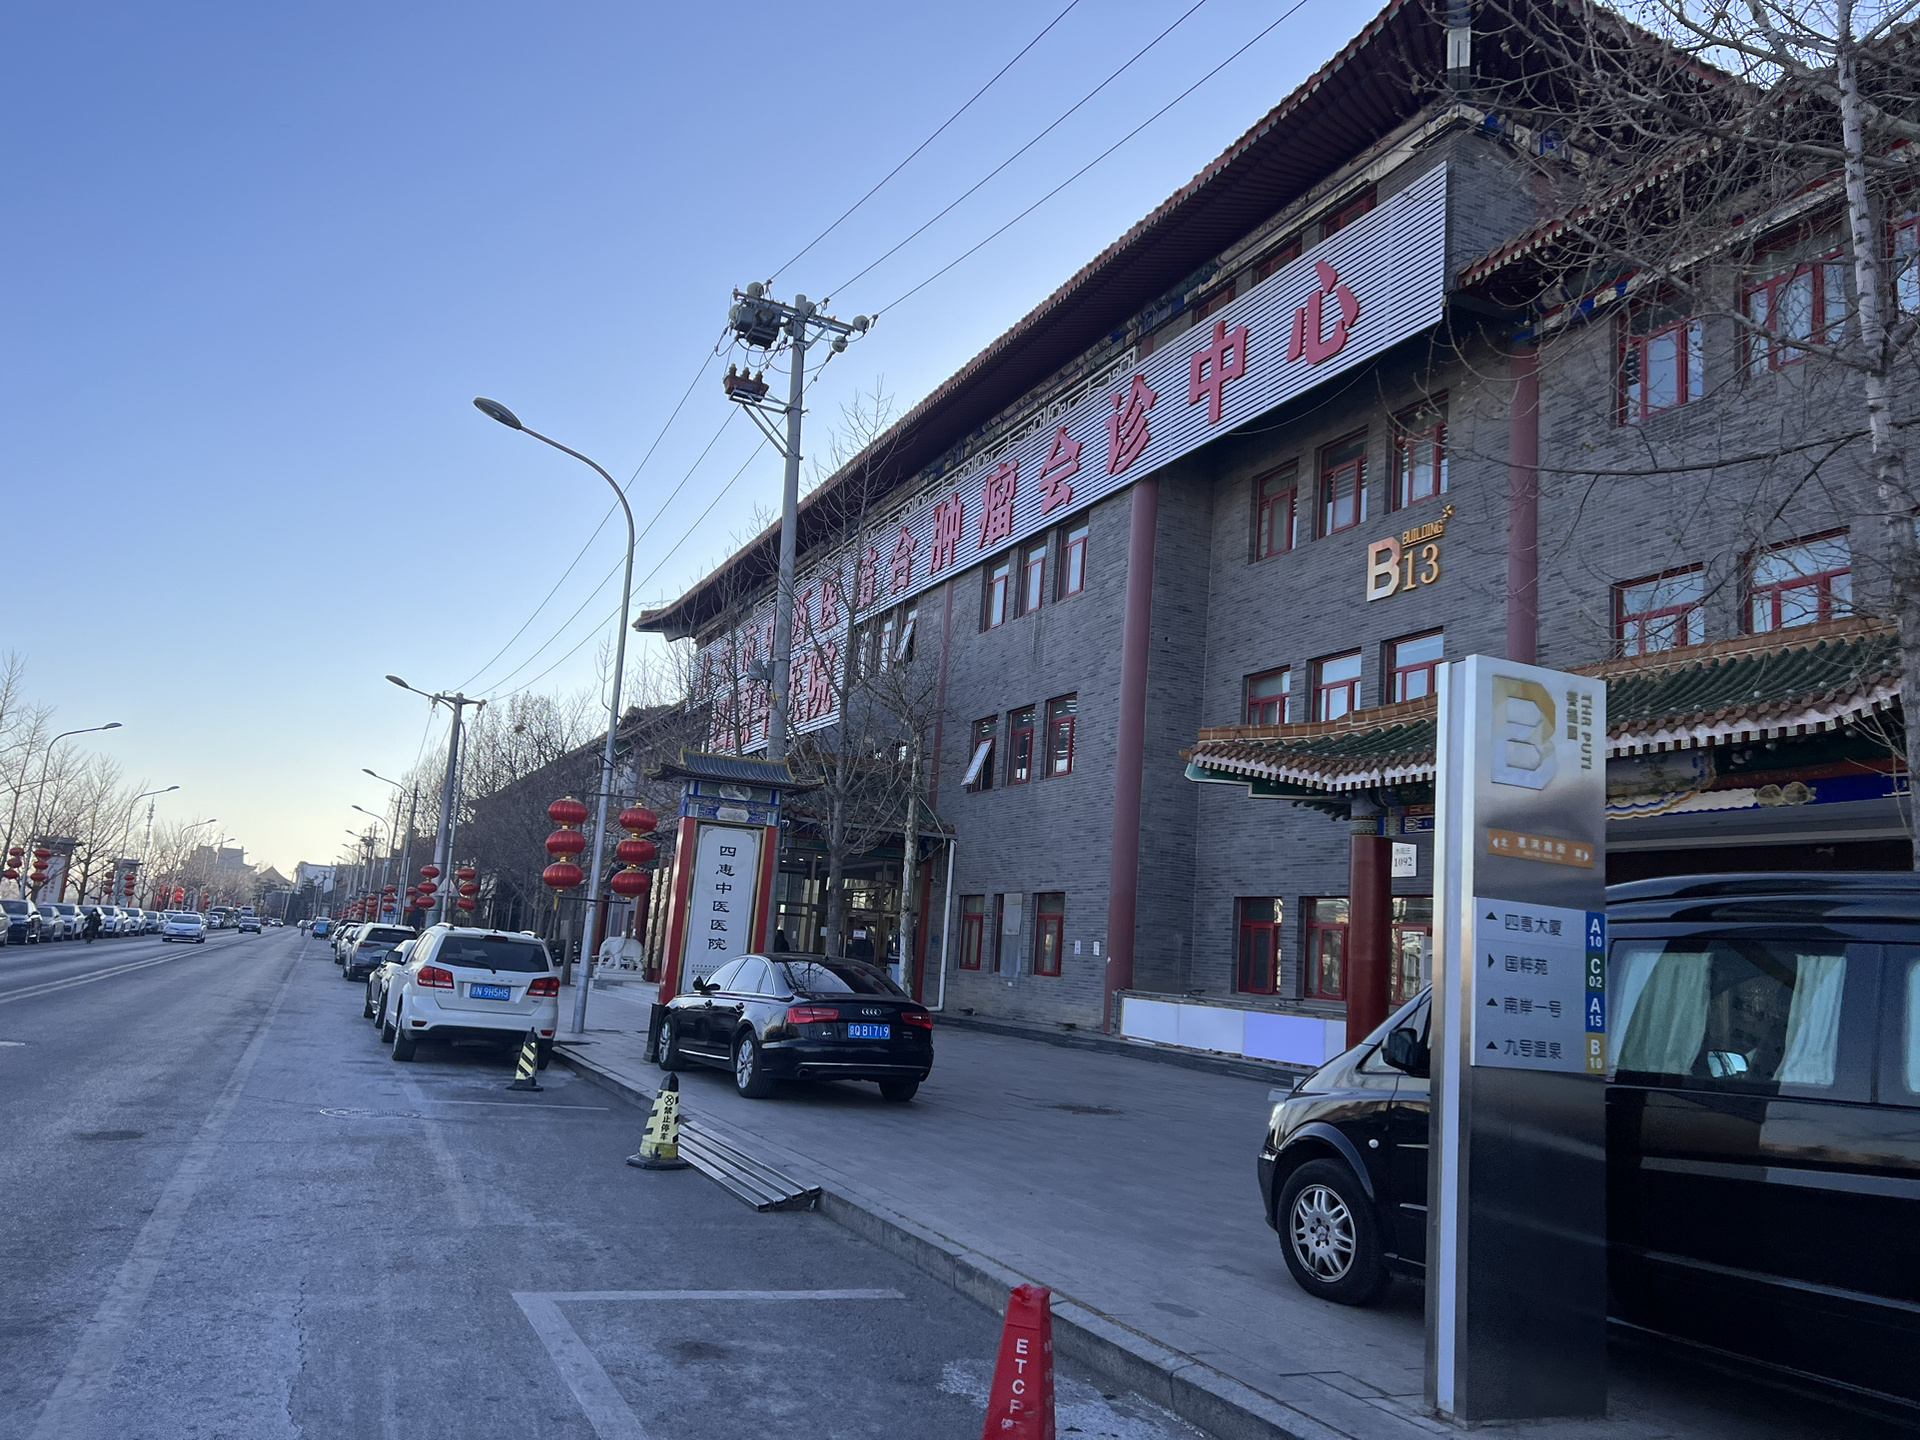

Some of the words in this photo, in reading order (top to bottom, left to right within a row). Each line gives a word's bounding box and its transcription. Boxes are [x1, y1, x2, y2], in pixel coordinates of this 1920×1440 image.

[1402, 519, 1444, 545] BUILDING
[1366, 536, 1400, 602] B
[1402, 543, 1439, 591] 13
[707, 845, 737, 951] 四惠中医医院
[1504, 913, 1562, 937] 四惠大厦
[1590, 918, 1601, 934] A
[1588, 935, 1603, 948] 10
[1590, 958, 1601, 974] C
[1588, 976, 1603, 988] 02
[1504, 996, 1562, 1018] 南岸一号
[1590, 997, 1601, 1013] A
[1588, 1015, 1603, 1027] 15
[1503, 1039, 1562, 1060] 九号温泉
[1590, 1039, 1601, 1055] B
[660, 1106, 672, 1141] 禁止停车
